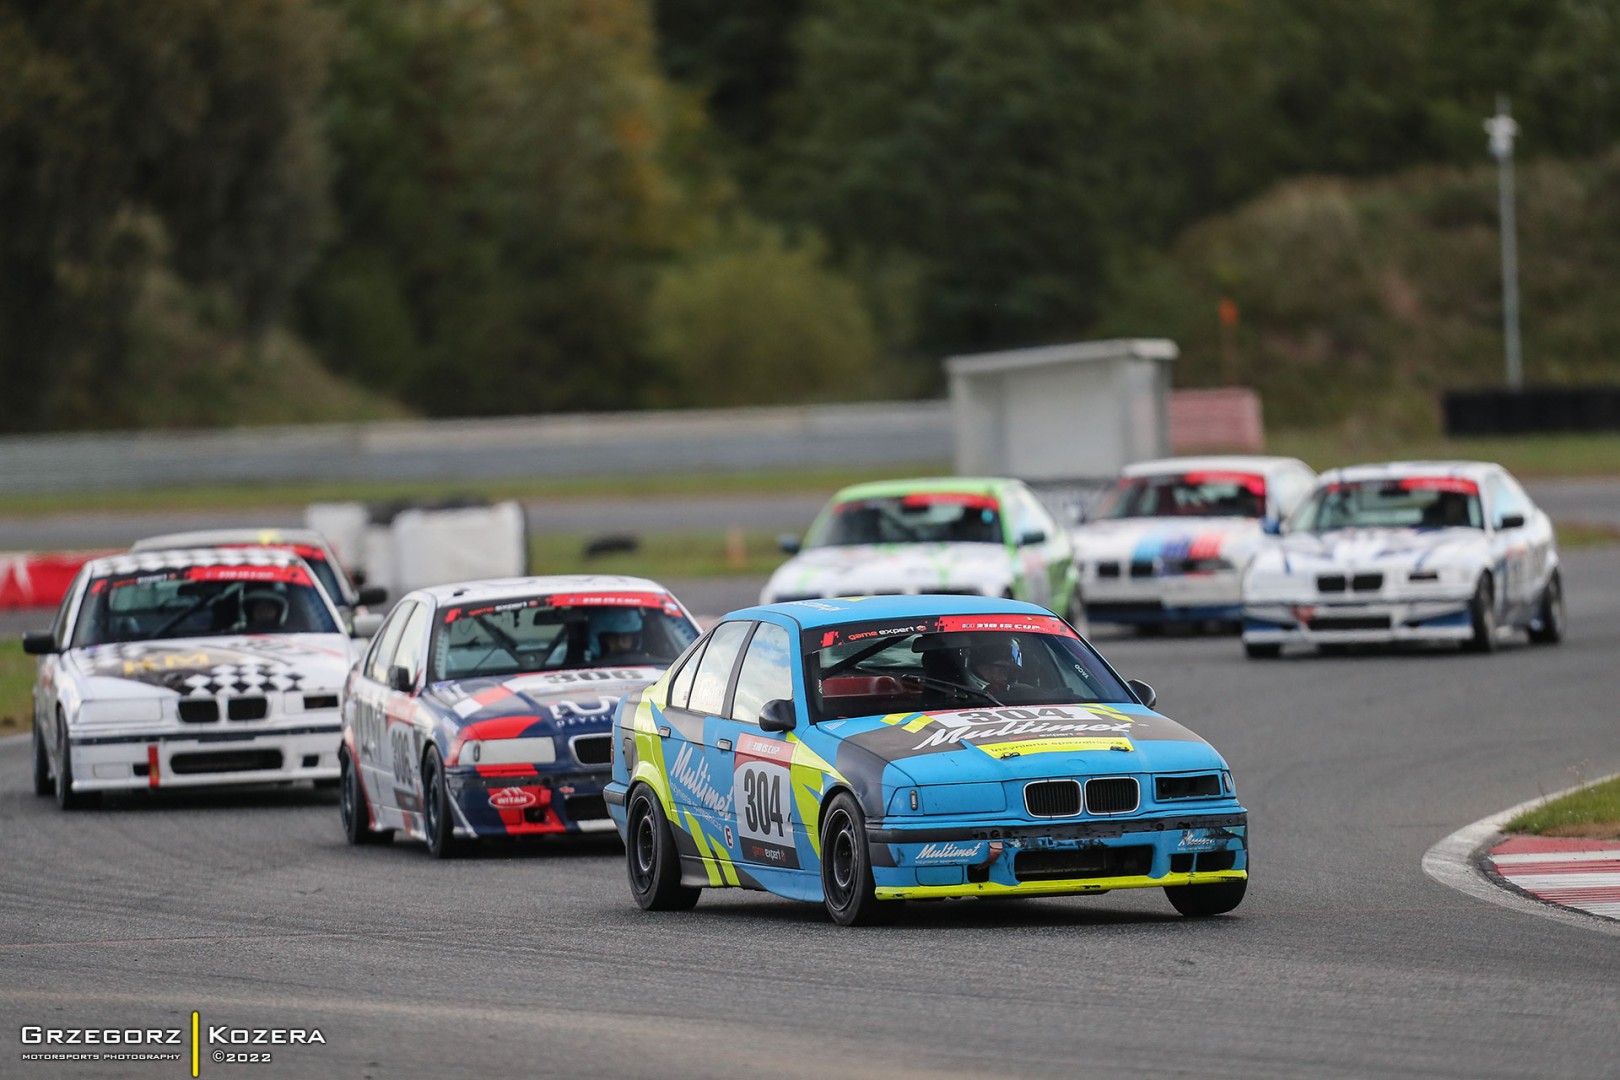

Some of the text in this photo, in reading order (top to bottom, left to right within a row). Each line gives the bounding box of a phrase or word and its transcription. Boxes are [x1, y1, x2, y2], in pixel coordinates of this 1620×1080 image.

[848, 626, 915, 642] game expert
[544, 669, 643, 683] 306
[957, 707, 1075, 724] 304
[912, 720, 1133, 750] Multimet
[670, 741, 734, 821] Multimet
[744, 768, 784, 838] 304
[915, 842, 981, 860] Multimet
